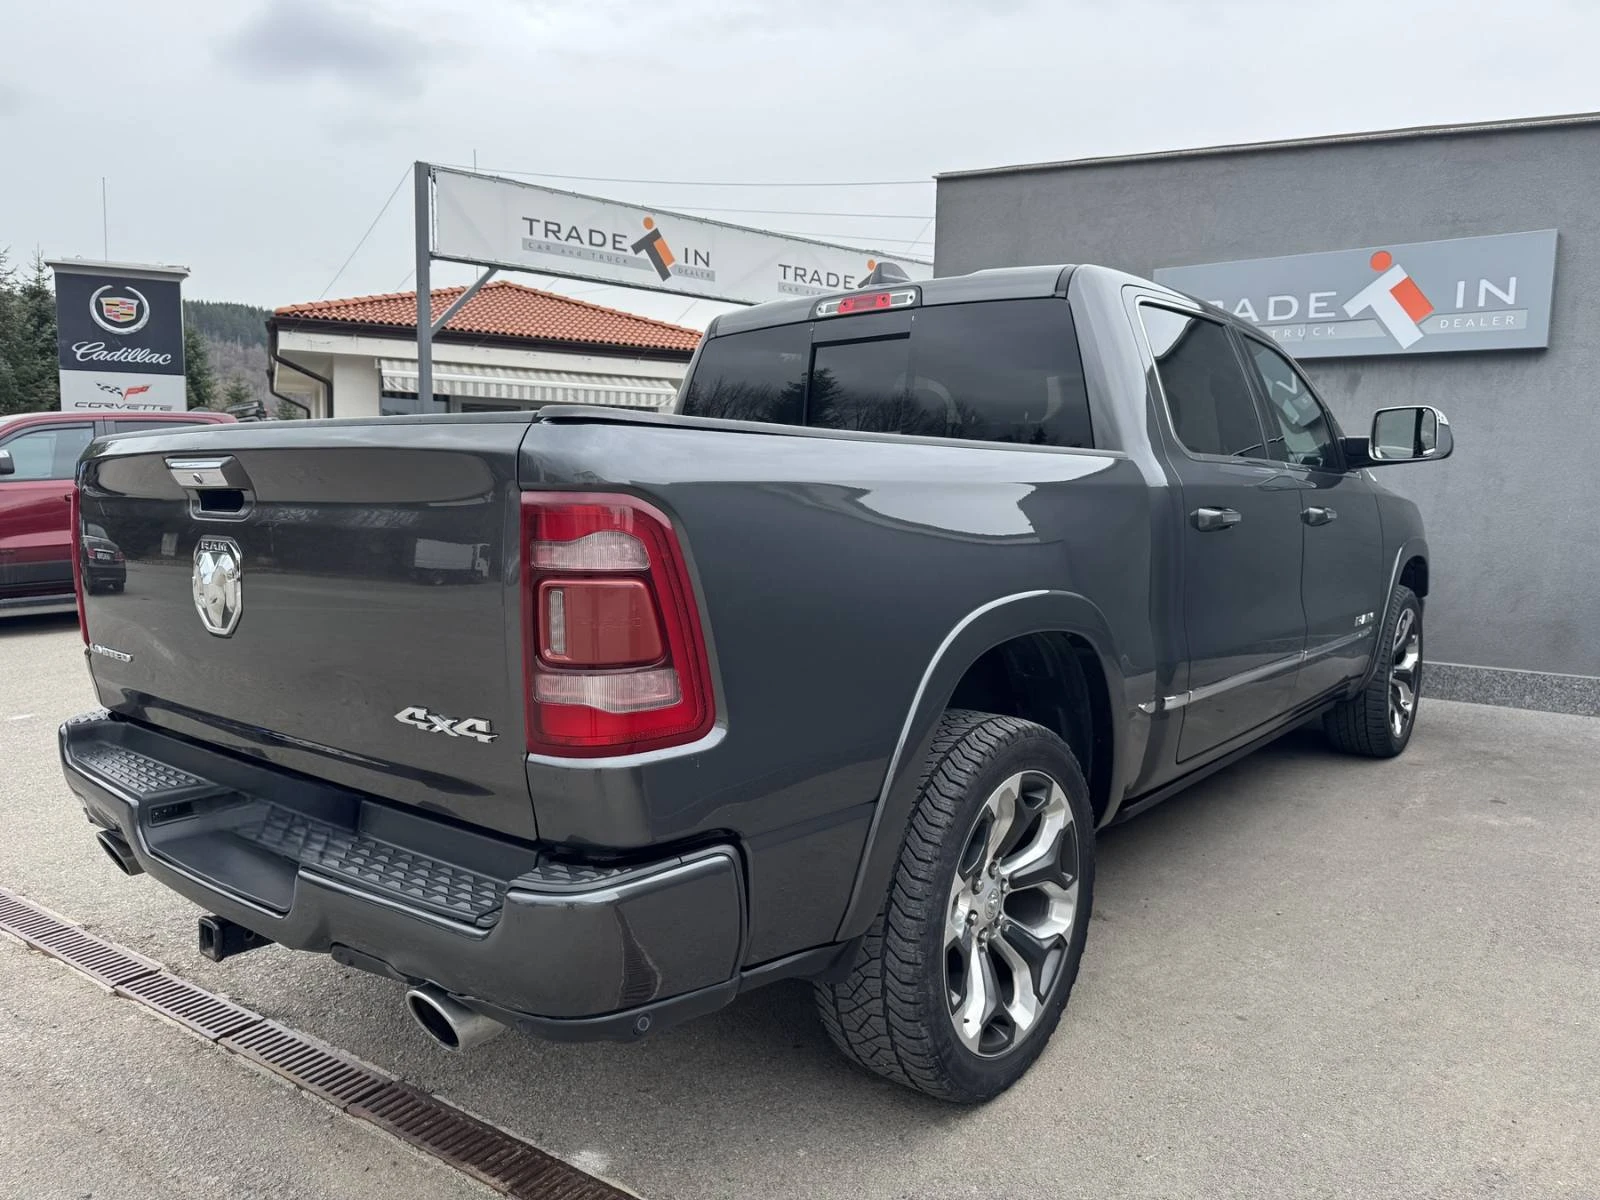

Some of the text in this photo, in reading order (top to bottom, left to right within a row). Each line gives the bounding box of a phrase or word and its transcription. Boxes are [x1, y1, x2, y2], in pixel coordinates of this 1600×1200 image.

[522, 217, 628, 252] TRADE
[684, 247, 710, 268] IN
[778, 263, 855, 290] TRADE
[1207, 291, 1337, 322] ADE
[1455, 276, 1517, 309] IN
[1270, 315, 1515, 338] TRUCK DEALER
[72, 341, 171, 365] Cadillac
[75, 401, 173, 412] CORVETTE
[200, 541, 228, 551] RAM
